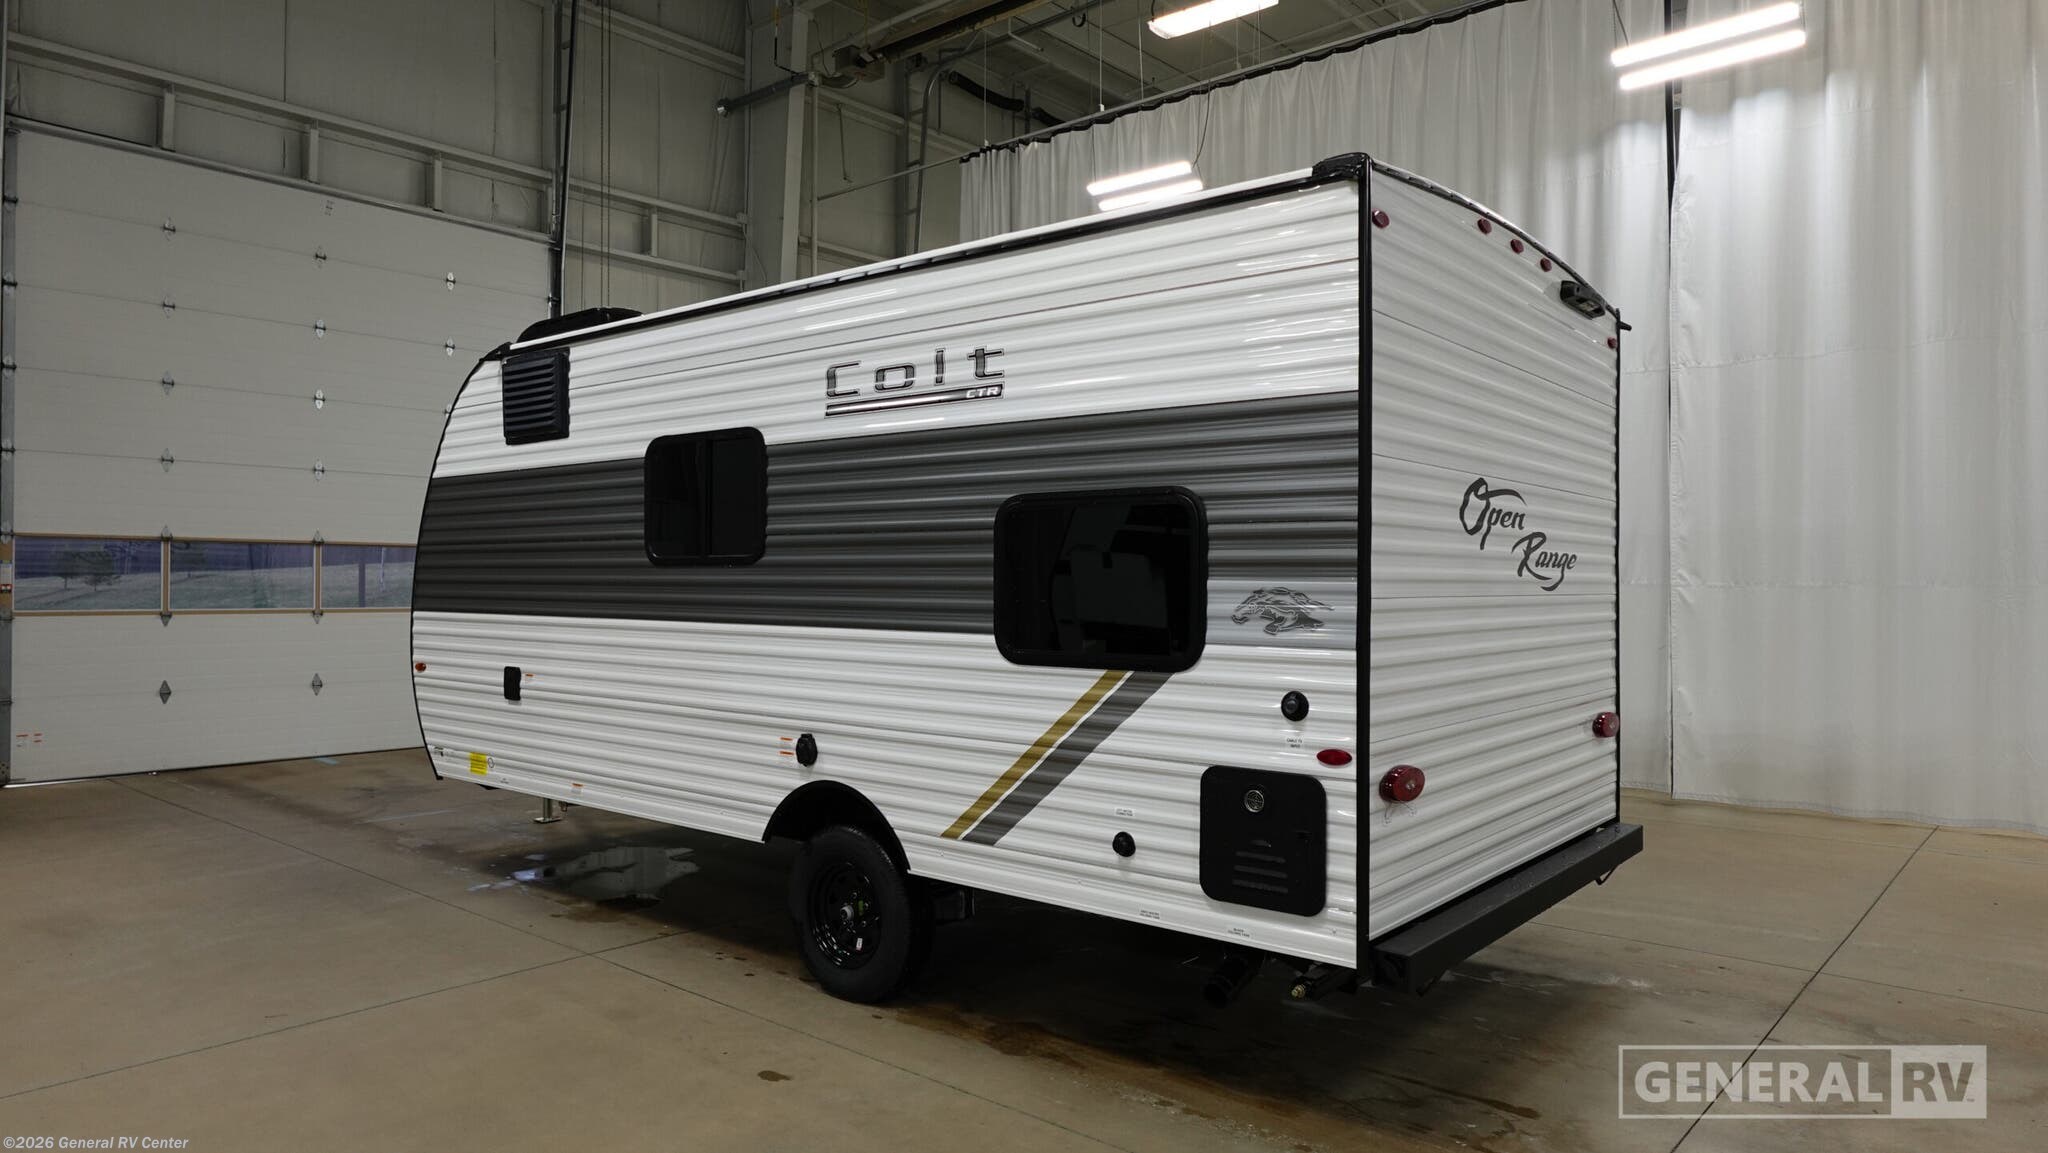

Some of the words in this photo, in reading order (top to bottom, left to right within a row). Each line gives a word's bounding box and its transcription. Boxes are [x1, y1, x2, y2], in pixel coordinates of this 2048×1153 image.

[826, 347, 1004, 397] Colt
[966, 386, 999, 398] CTR
[1459, 477, 1527, 550] Open
[1511, 531, 1577, 592] Range
